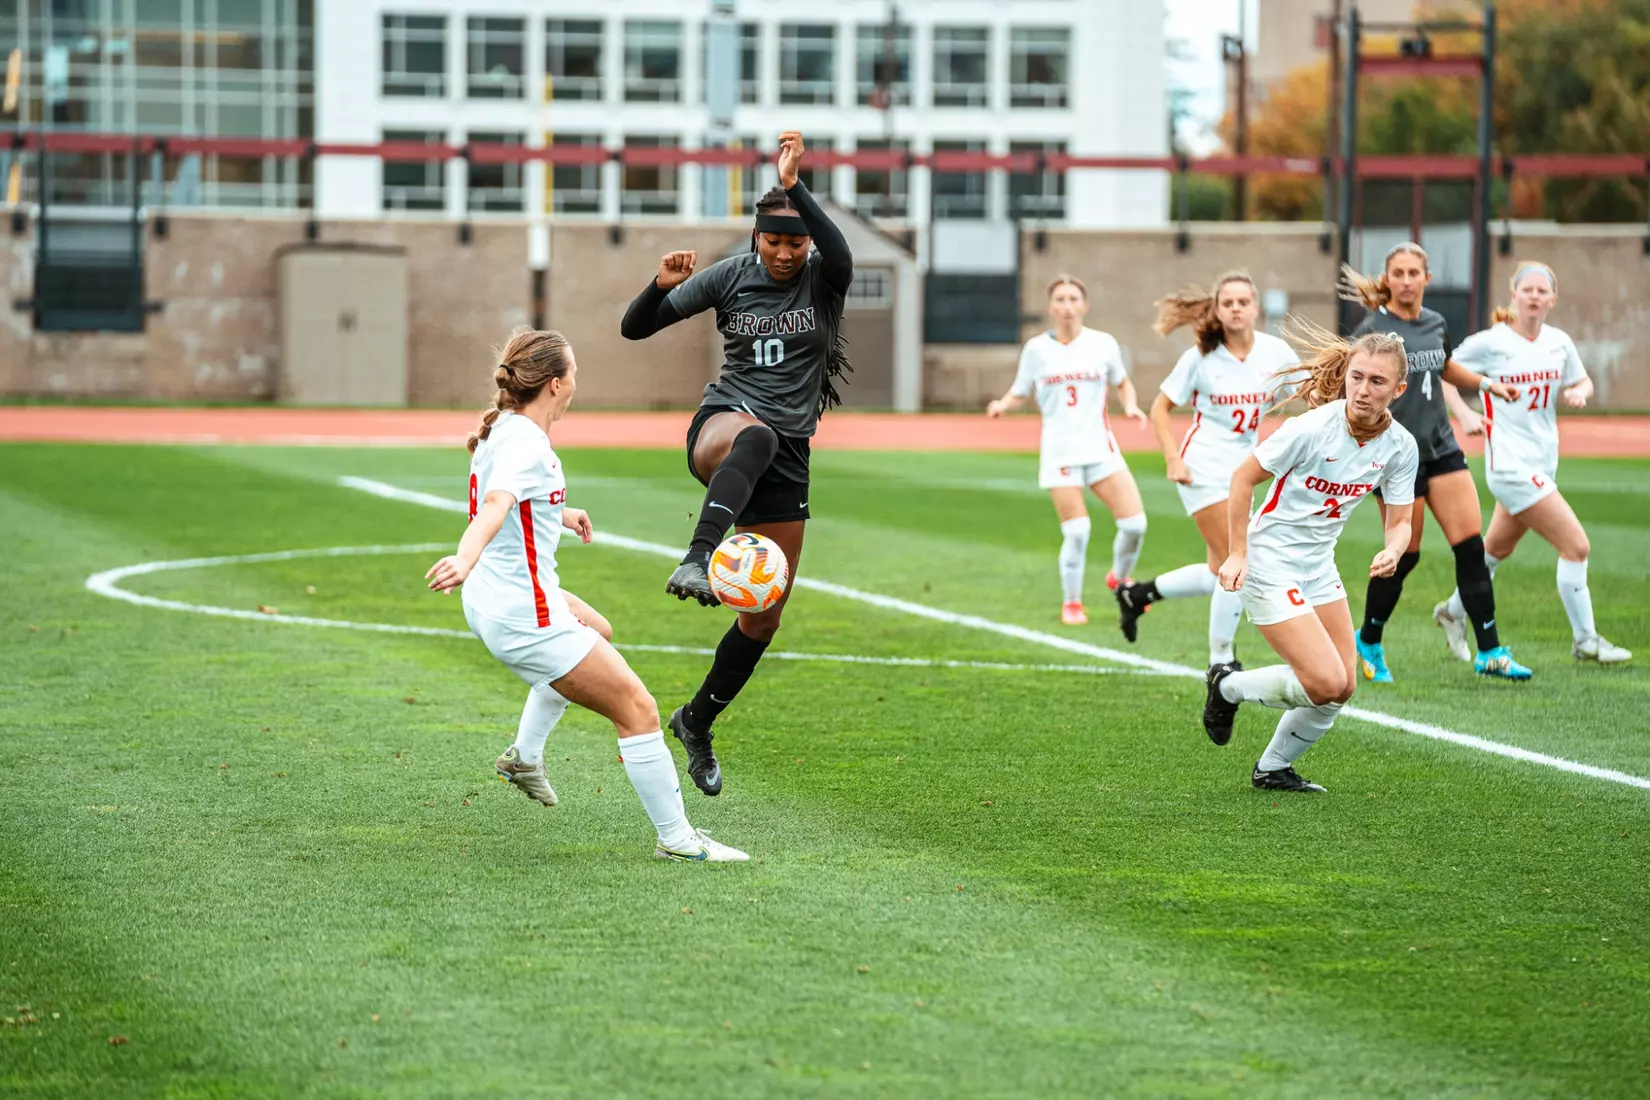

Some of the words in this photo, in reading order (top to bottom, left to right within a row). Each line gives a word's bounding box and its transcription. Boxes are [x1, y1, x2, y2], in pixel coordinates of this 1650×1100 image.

[726, 307, 816, 336] BROWN
[752, 339, 784, 366] 10
[1066, 385, 1078, 407] 3
[1421, 370, 1433, 401] 4
[1528, 384, 1550, 411] 21
[1231, 408, 1260, 434] 24
[1287, 588, 1305, 606] C
